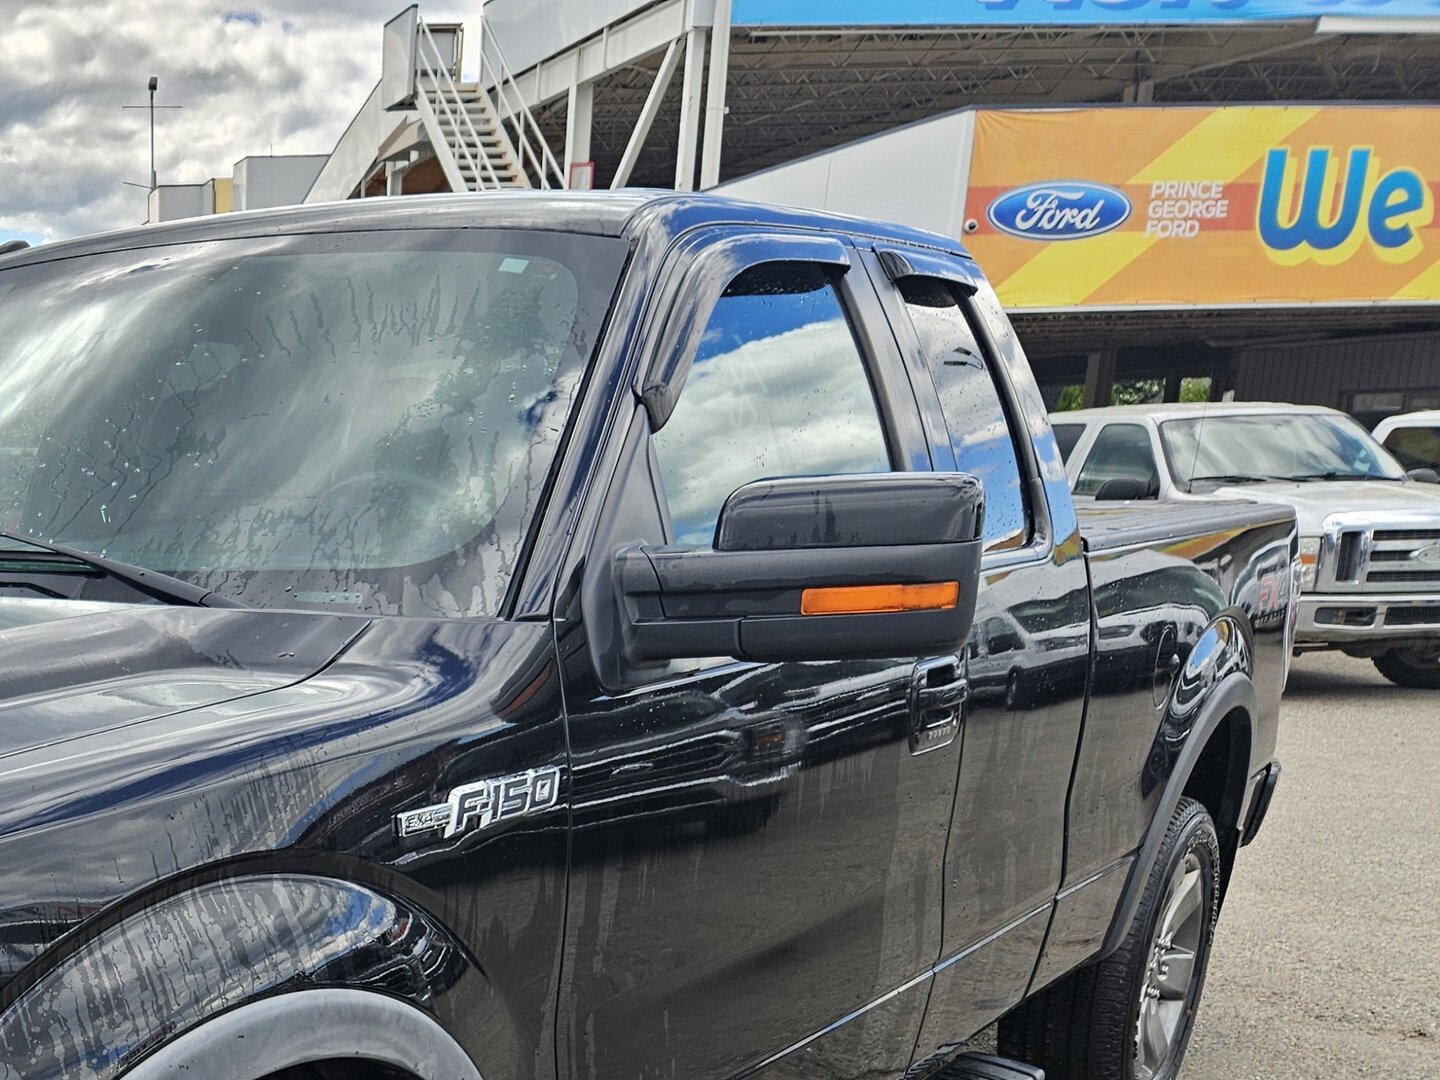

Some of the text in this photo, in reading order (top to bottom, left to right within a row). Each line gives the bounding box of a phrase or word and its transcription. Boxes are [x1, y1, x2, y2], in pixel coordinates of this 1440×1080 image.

[1150, 181, 1224, 199] PRINCE
[1148, 200, 1229, 218] GEORGE
[1257, 147, 1425, 253] We
[1015, 189, 1105, 230] Ford
[1144, 220, 1200, 238] FORD
